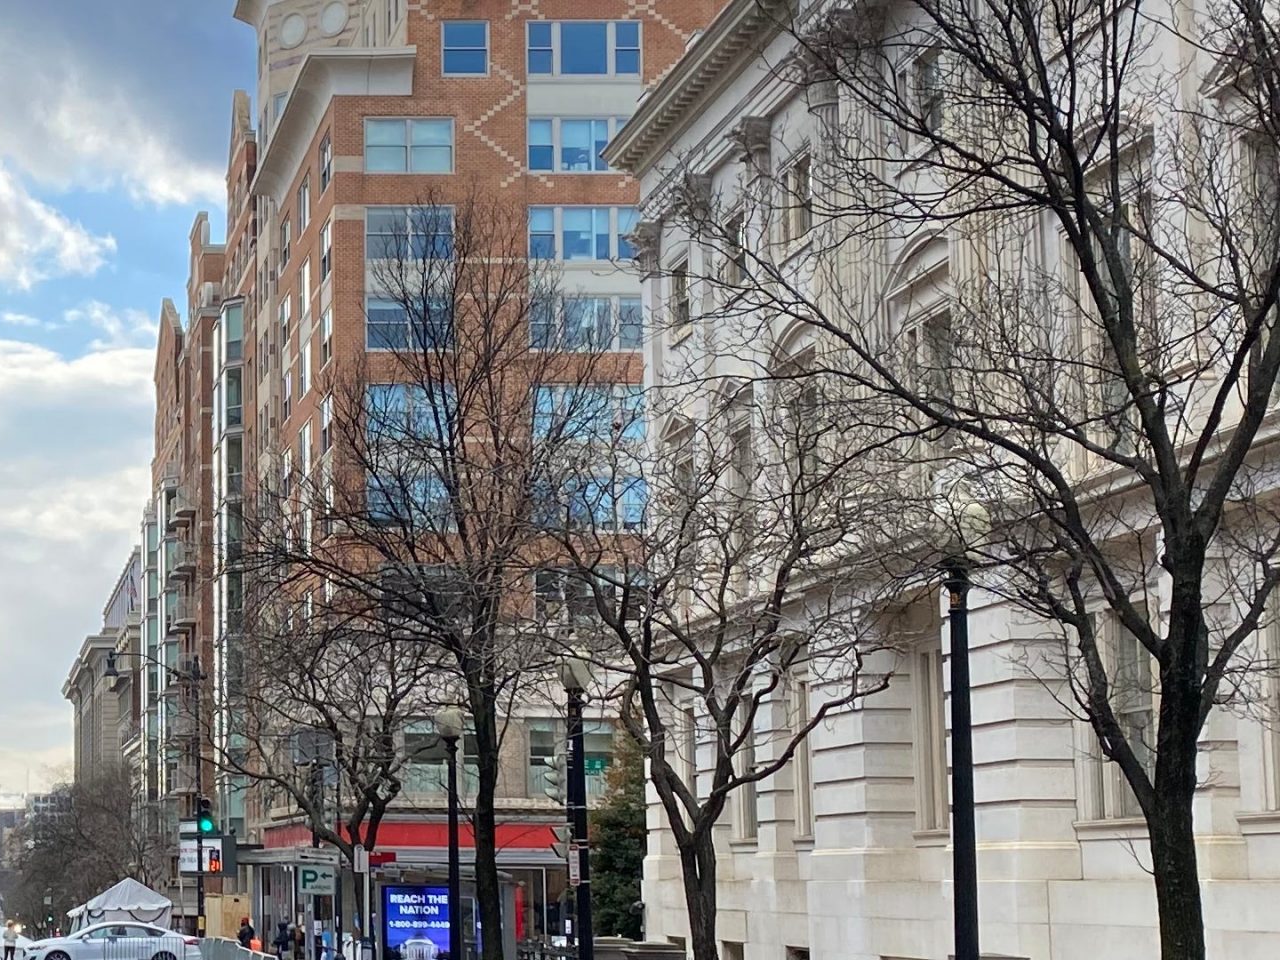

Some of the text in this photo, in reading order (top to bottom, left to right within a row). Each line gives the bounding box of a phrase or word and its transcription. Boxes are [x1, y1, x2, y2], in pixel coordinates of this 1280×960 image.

[390, 894, 448, 904] REACH THE
[400, 905, 439, 915] NATION
